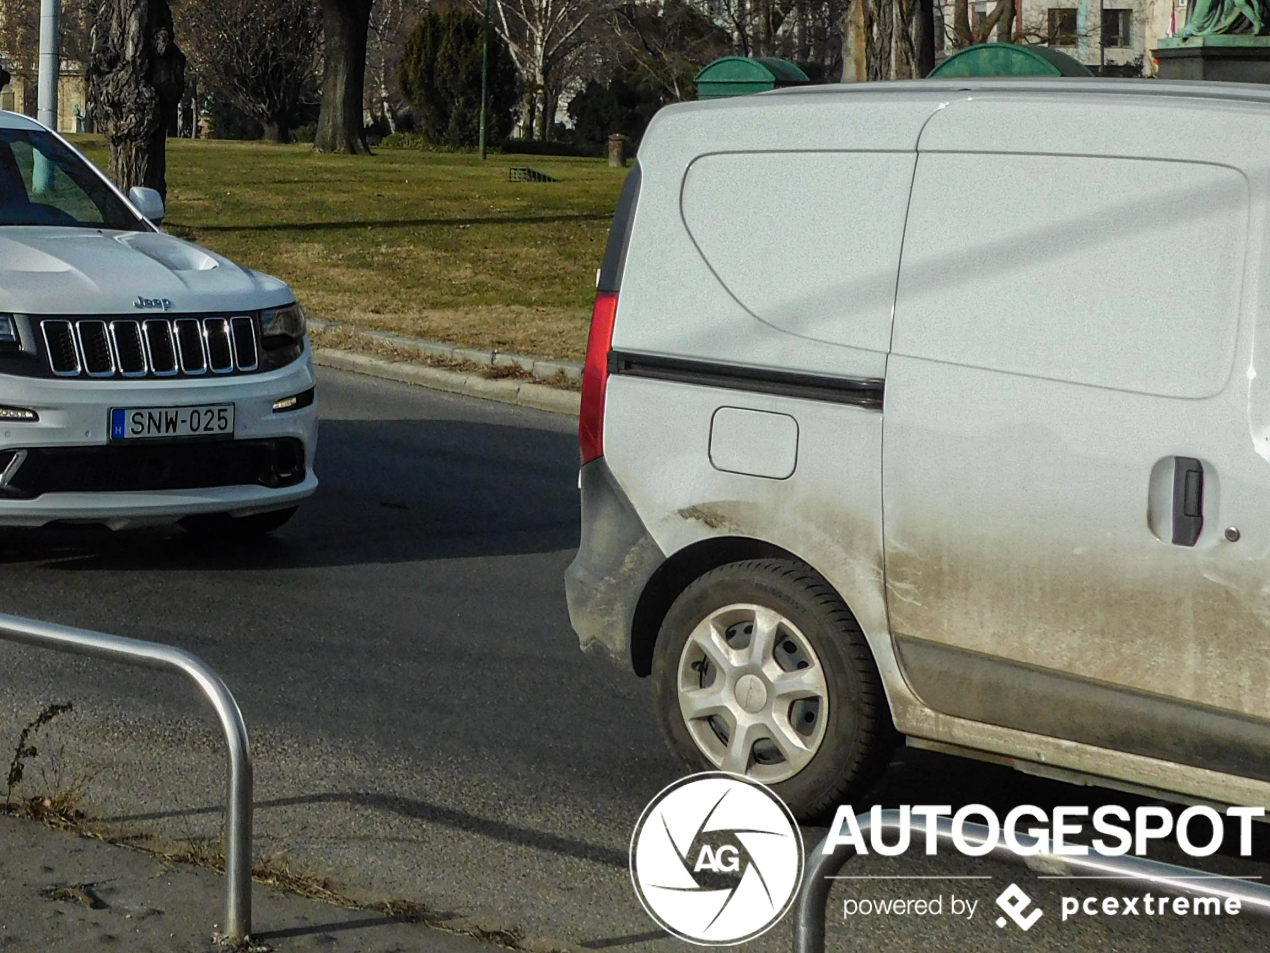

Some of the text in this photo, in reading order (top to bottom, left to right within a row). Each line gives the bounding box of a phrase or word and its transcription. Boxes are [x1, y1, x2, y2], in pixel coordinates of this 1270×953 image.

[132, 296, 172, 311] Jeep
[130, 409, 228, 435] SNW-025
[115, 426, 122, 435] H
